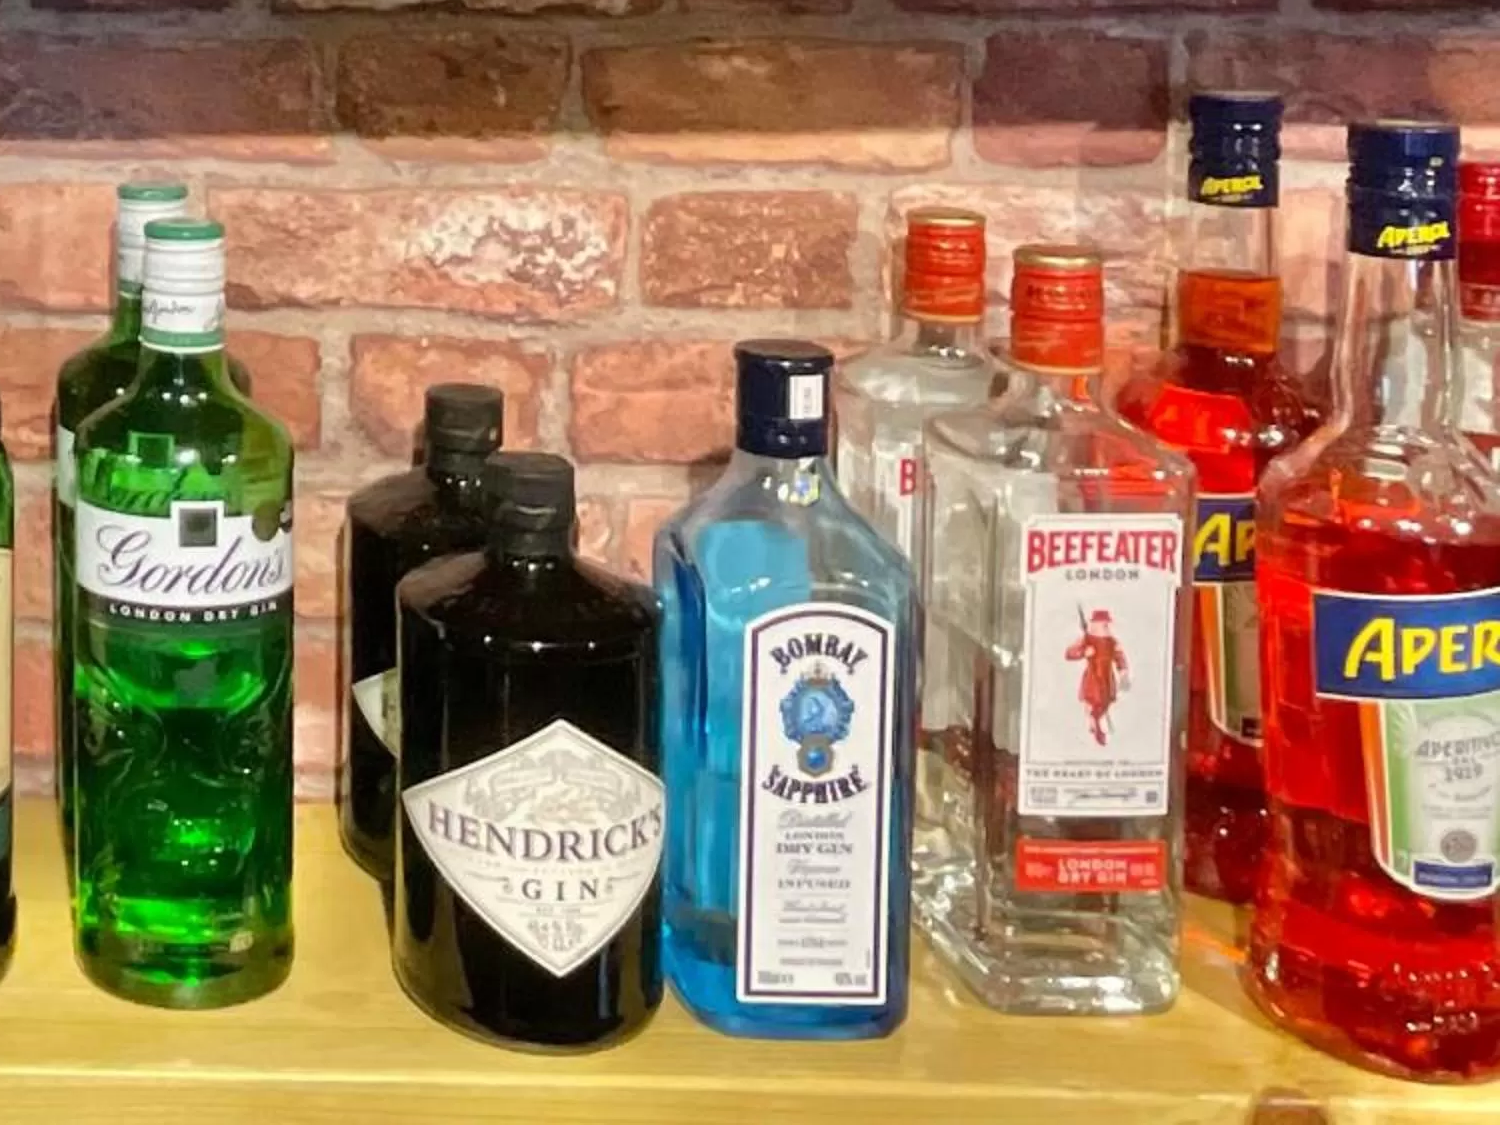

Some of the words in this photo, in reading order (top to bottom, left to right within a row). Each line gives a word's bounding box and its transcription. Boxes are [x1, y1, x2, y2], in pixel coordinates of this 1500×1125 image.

[95, 523, 286, 595] Gordon's
[1026, 528, 1178, 573] BEEFEATER
[1065, 569, 1140, 581] LONDON
[109, 603, 192, 622] LONDON
[203, 609, 239, 622] DRY
[768, 632, 869, 674] BOMBAY
[761, 764, 871, 804] SAPPHIRE
[428, 801, 662, 864] HENDRICK'S
[1057, 858, 1127, 871] LONDON
[521, 877, 598, 902] GIN
